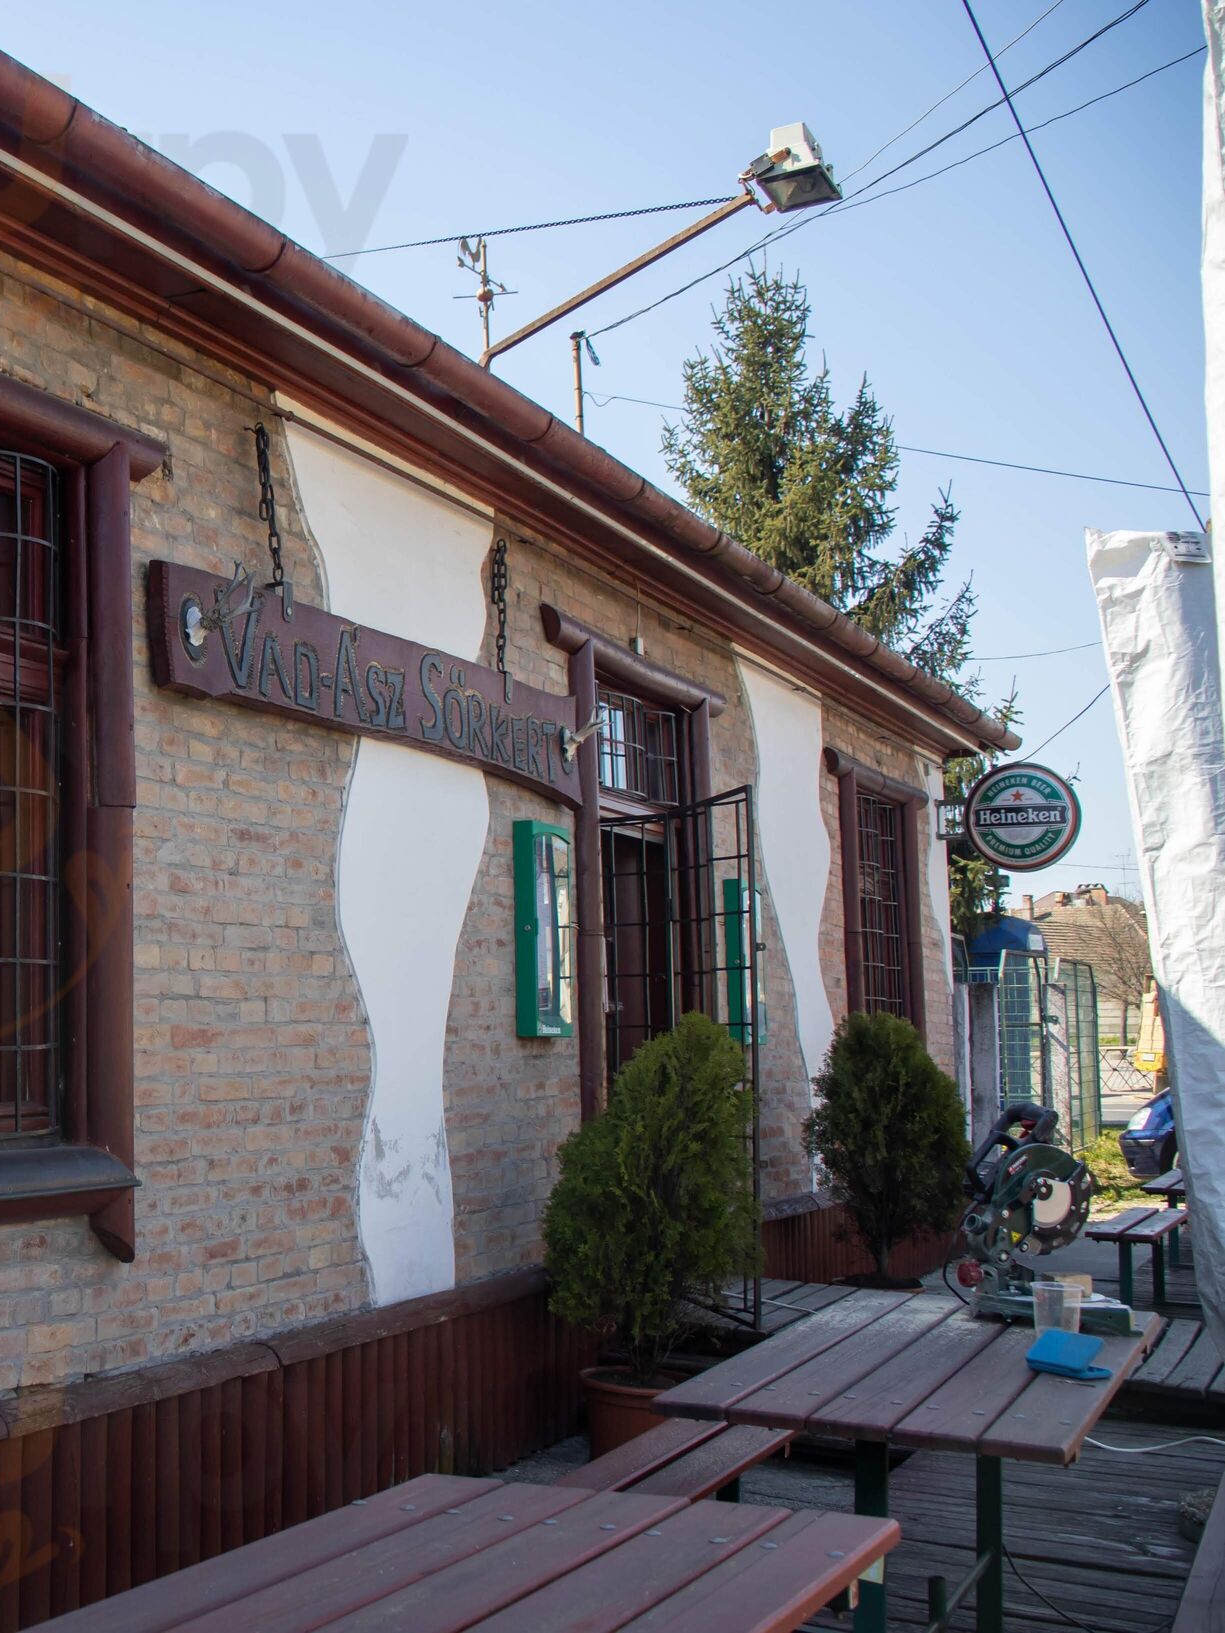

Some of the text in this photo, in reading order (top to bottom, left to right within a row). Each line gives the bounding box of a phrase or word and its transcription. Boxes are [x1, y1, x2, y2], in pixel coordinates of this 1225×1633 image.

[419, 651, 557, 783] SÖRKERT
[986, 776, 1053, 797] HEINEKEN BEER
[979, 808, 1061, 825] Heineken
[985, 832, 1056, 856] PREMIUM QUALITY
